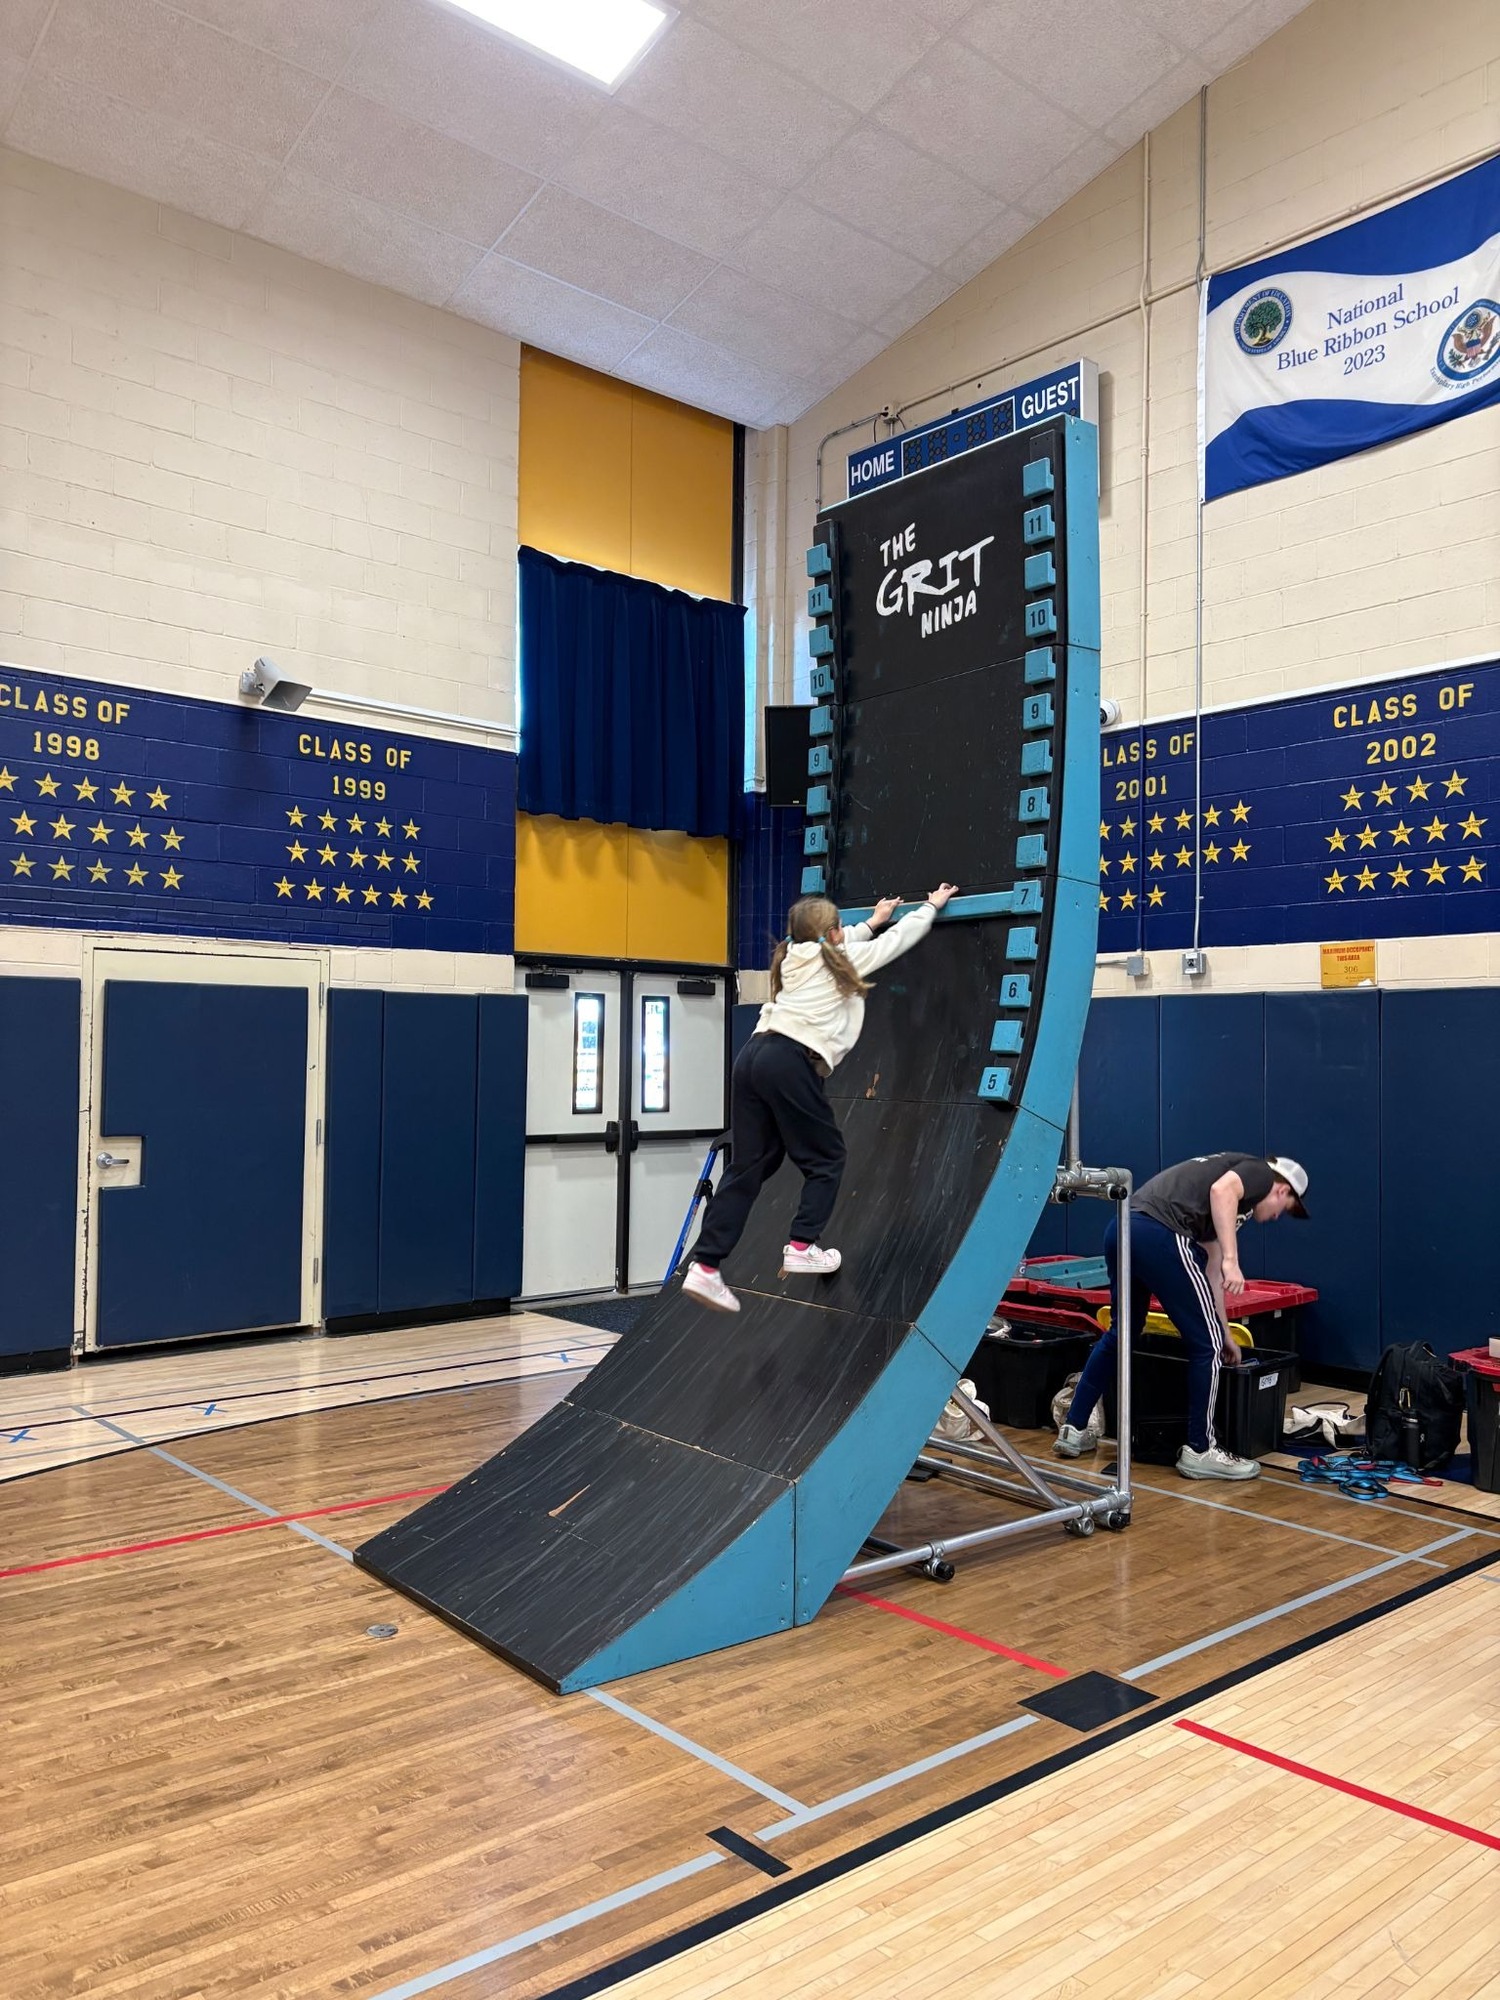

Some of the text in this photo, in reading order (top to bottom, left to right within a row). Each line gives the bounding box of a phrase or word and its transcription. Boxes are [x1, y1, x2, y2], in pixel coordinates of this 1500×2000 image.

[1327, 283, 1404, 330] National
[1277, 350, 1318, 371] Blue
[1324, 323, 1387, 357] Ribbon
[1393, 286, 1459, 330] School
[1343, 345, 1386, 375] 2023
[1021, 376, 1079, 420] GUEST
[851, 450, 895, 486] HOME
[1029, 515, 1042, 534] 11
[880, 522, 916, 567] THE
[875, 535, 995, 617] GRIT
[811, 592, 821, 608] 11
[921, 589, 977, 639] NINJA
[1030, 609, 1046, 628] 10
[813, 674, 824, 689] 10
[0, 683, 130, 725] CLASS OF
[1031, 703, 1039, 719] 9
[1333, 683, 1474, 729] CLASS OF
[33, 731, 100, 761] 1998
[299, 734, 412, 769] CLASS OF
[814, 753, 820, 767] 9
[1103, 732, 1195, 767] LASS OF
[1366, 732, 1436, 765] 2002
[333, 775, 386, 801] 1999
[1115, 775, 1167, 801] 2001
[1027, 796, 1035, 812] 8
[810, 832, 816, 845] 8
[1021, 888, 1029, 905] 7
[1009, 982, 1017, 998] 6
[988, 1074, 997, 1090] 5
